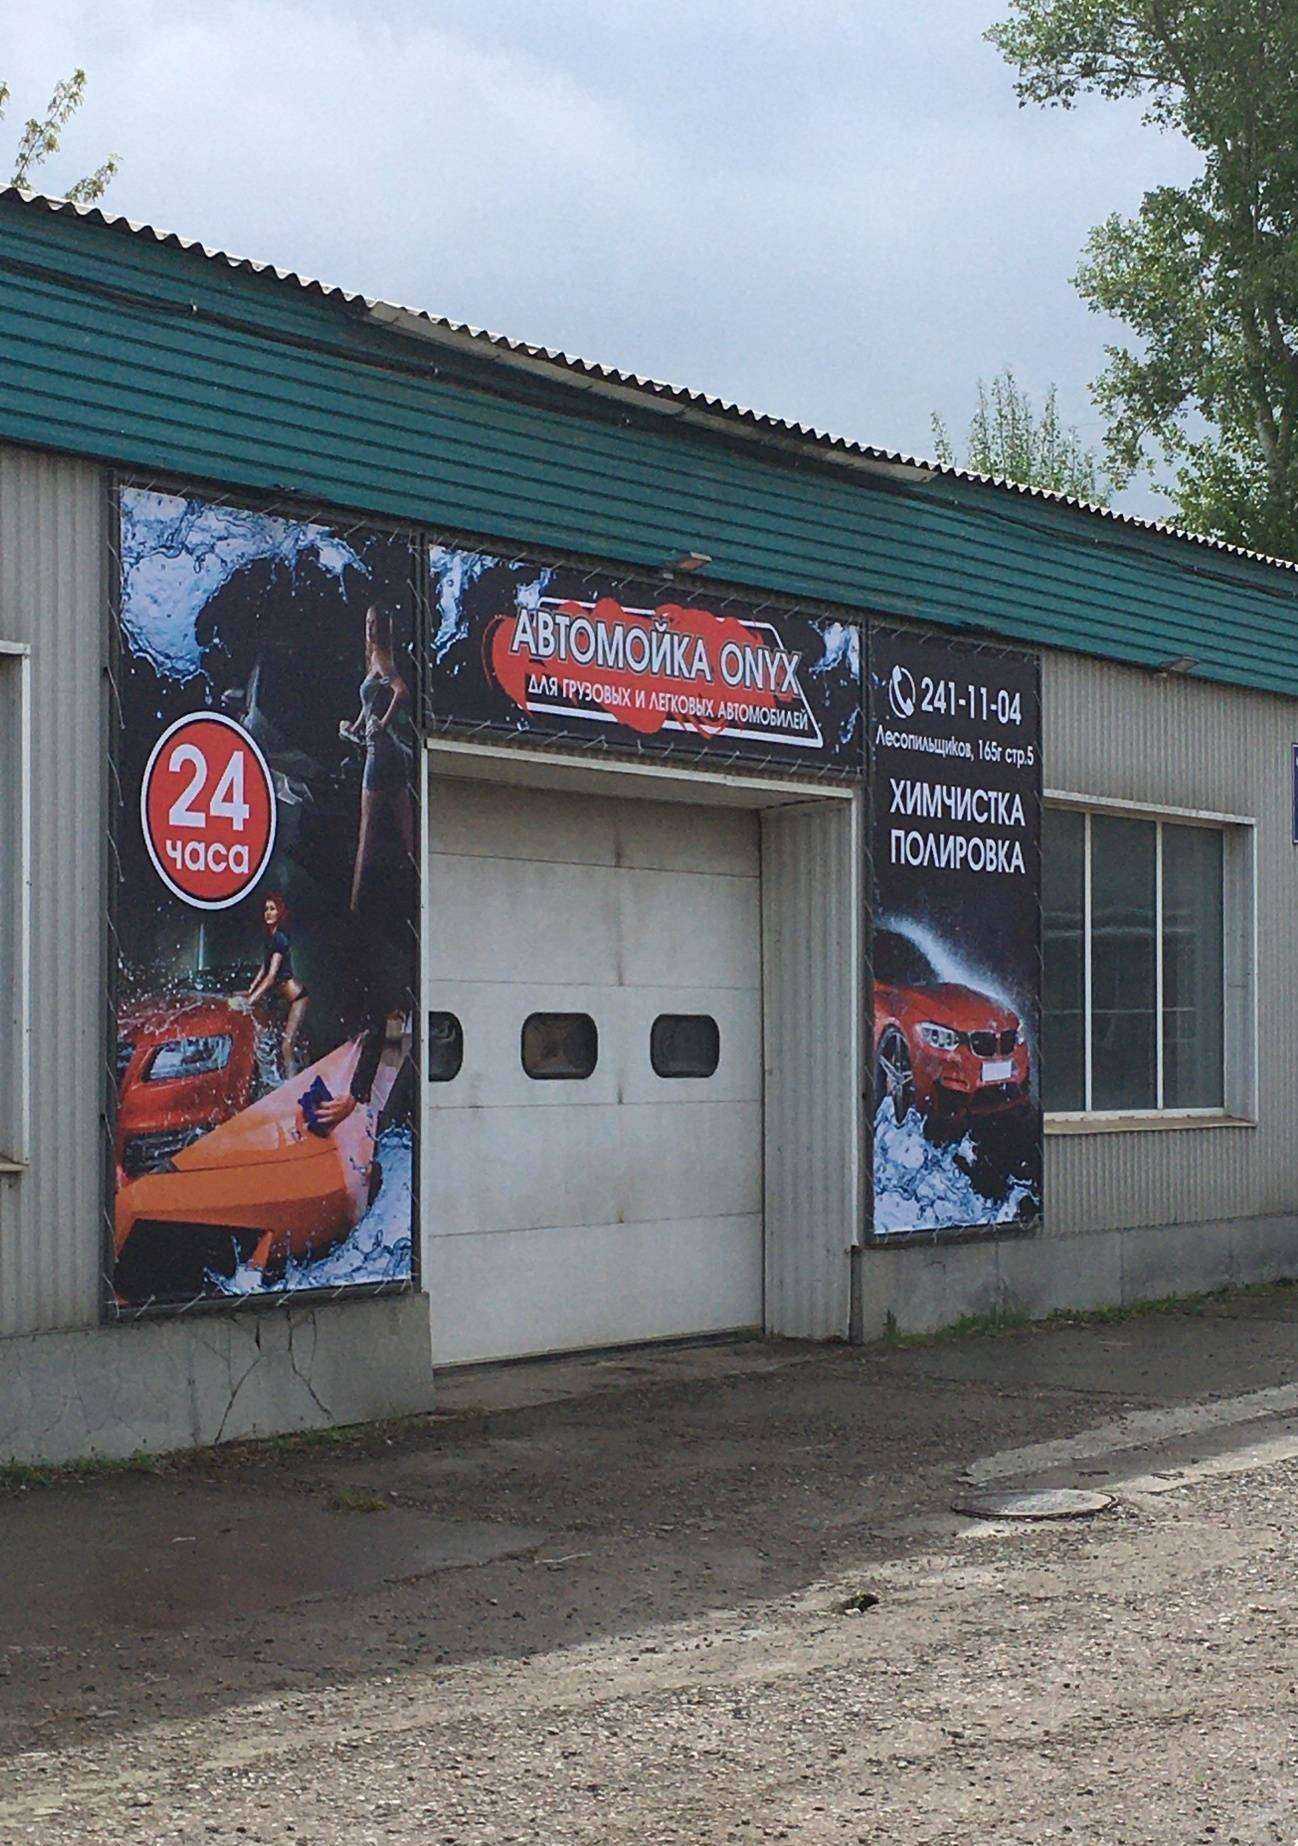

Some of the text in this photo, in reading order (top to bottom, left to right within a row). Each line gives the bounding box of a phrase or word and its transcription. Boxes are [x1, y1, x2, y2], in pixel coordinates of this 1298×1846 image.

[512, 608, 800, 696] АВТОМОЙКА ONYX
[528, 674, 809, 731] ДЛЯ ГРУЗОВЫХ И ЛЕГКОВЫХ АВТОМОБИЛЕЙ
[921, 676, 1022, 726] 241-11-04
[876, 724, 974, 762] Лесопильщиков,
[168, 743, 250, 831] 24
[889, 778, 1026, 827] ХИМЧИСТКА
[166, 839, 250, 875] часа
[890, 828, 1026, 874] ПОЛИРОВКА
